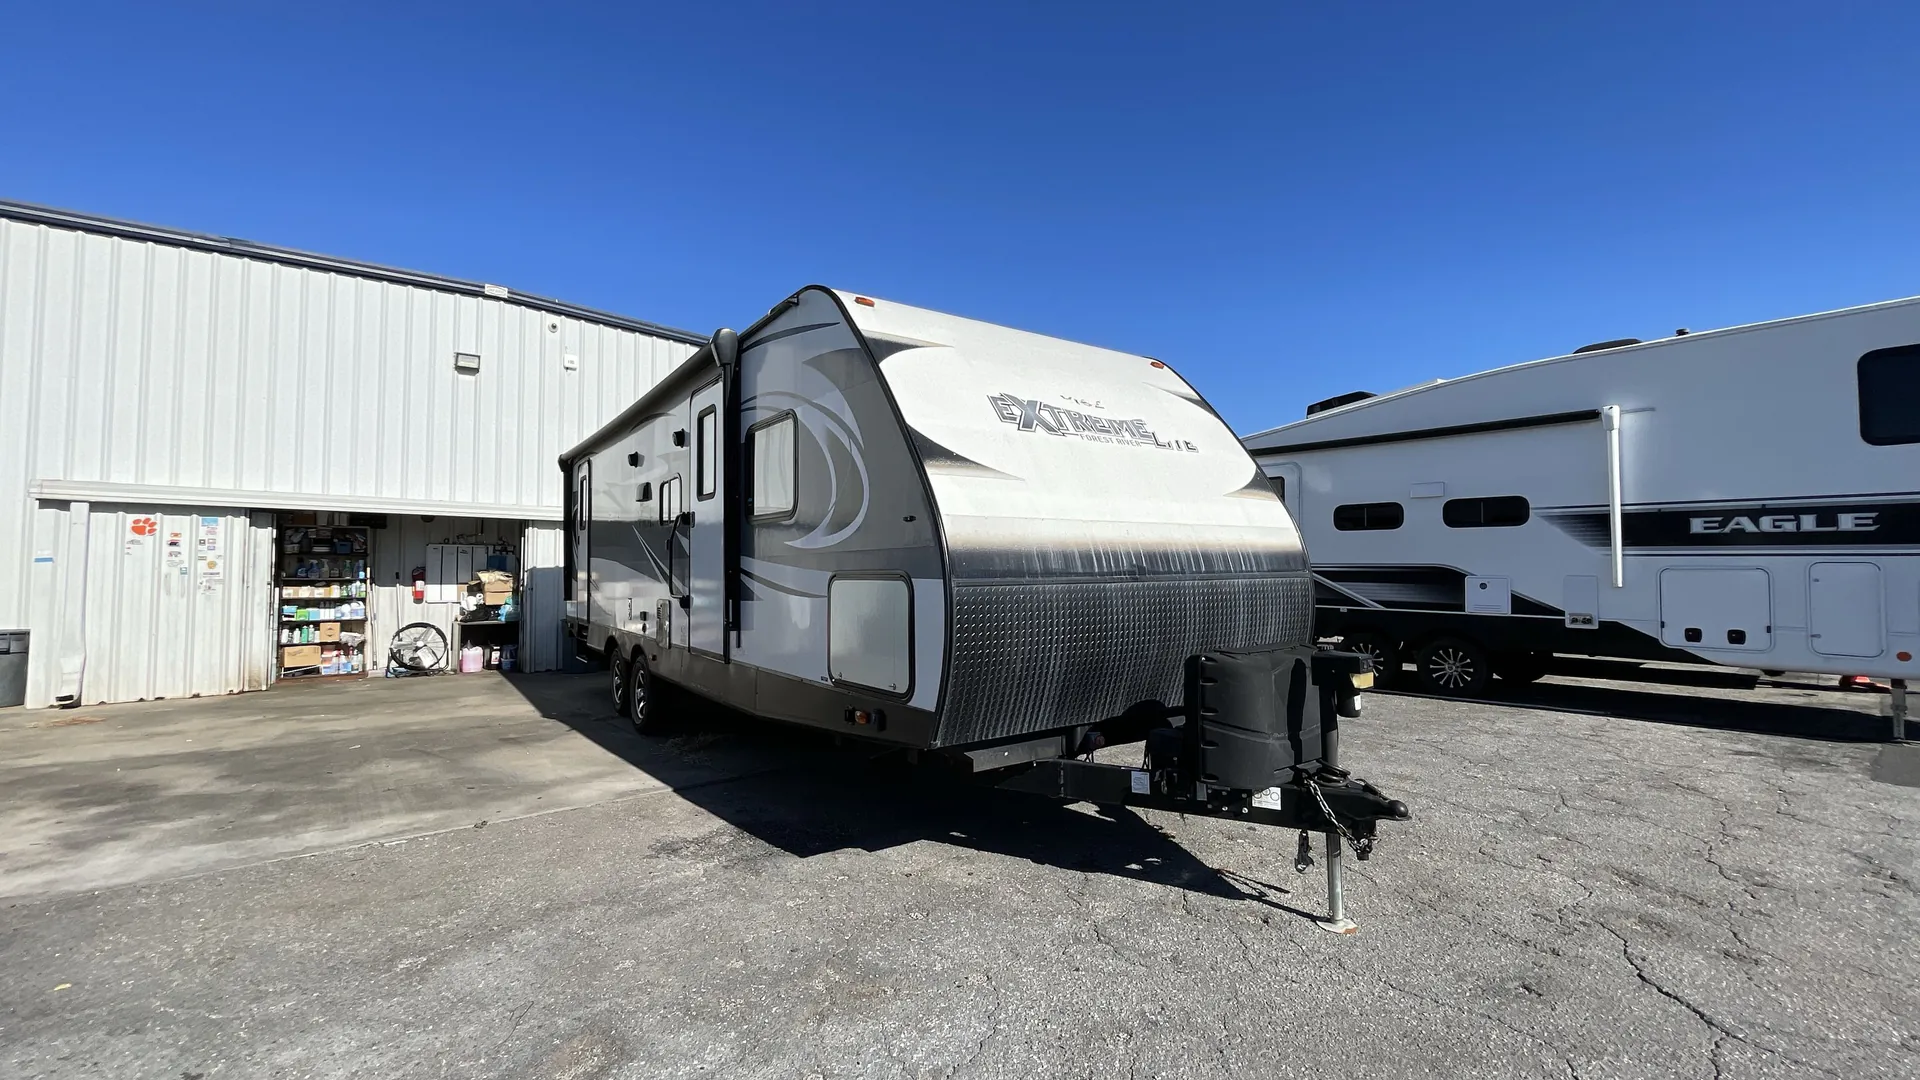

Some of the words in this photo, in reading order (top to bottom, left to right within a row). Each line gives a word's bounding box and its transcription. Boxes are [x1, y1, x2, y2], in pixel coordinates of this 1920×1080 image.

[986, 392, 1154, 441] EXTREME
[1080, 434, 1115, 444] FOREST
[1116, 436, 1142, 447] RIVER
[1689, 512, 1880, 534] EAGLE
